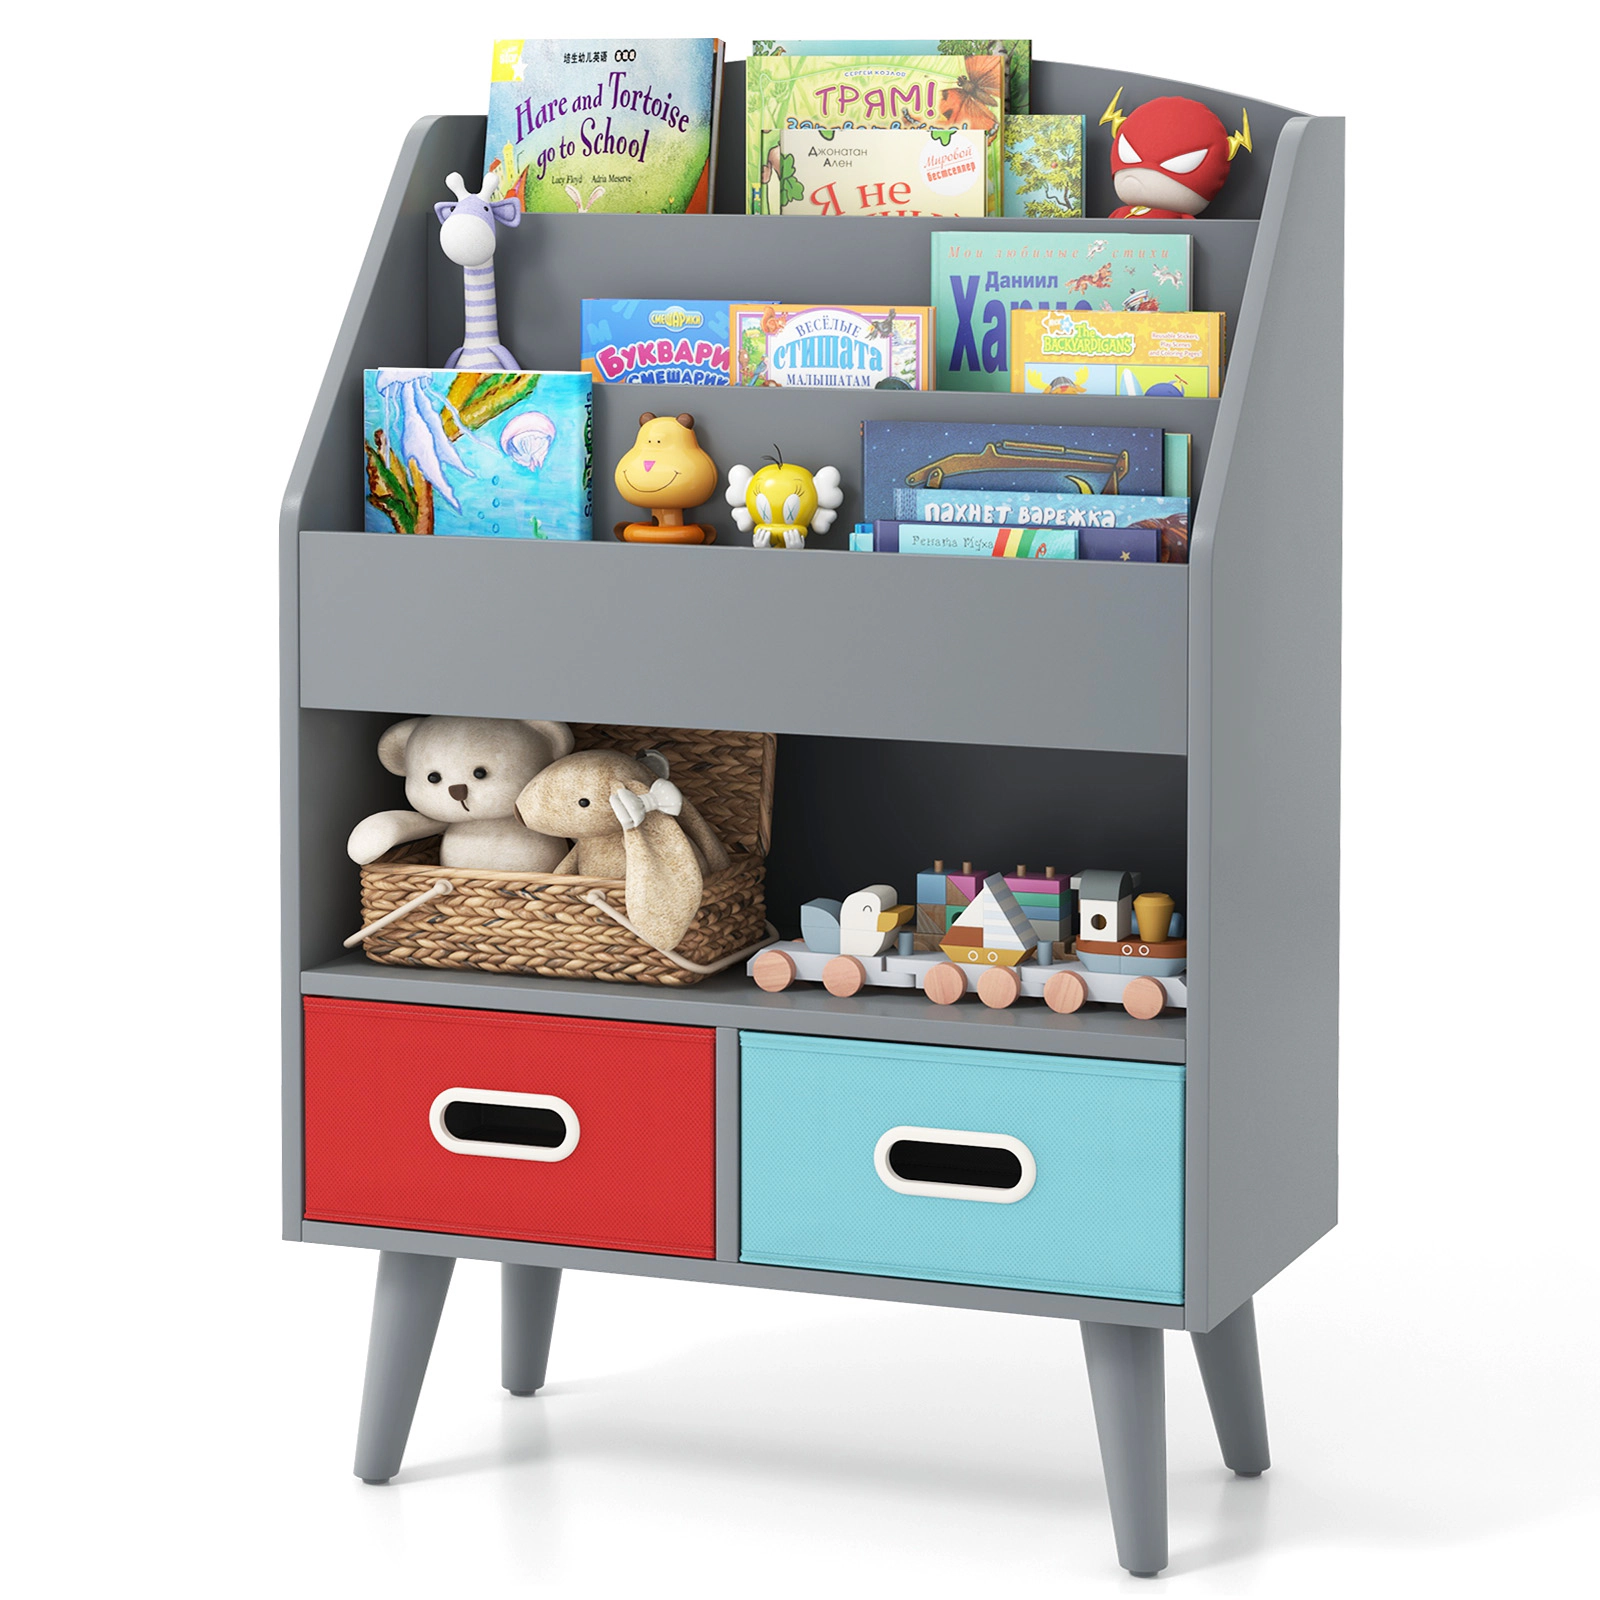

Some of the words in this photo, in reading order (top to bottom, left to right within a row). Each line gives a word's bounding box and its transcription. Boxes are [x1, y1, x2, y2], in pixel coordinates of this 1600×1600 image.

[563, 50, 608, 64] 培生幼儿英语
[515, 97, 568, 144] Hare
[572, 83, 603, 113] and
[608, 71, 690, 133] Tortoise
[815, 81, 936, 119] ТРЯМ!
[536, 147, 556, 180] go
[559, 136, 576, 159] to
[580, 116, 650, 163] School
[808, 146, 868, 157] Джонатан
[823, 158, 853, 168] Ален
[924, 145, 973, 170] Мировой
[566, 174, 583, 184] Floyd
[608, 174, 633, 184] Meserve
[926, 161, 977, 183] бестселлер
[810, 182, 846, 216] Я
[857, 182, 912, 209] не
[948, 246, 984, 259] Мои
[994, 245, 1080, 259] любимые
[1112, 248, 1170, 259] стихи
[985, 271, 1059, 292] Даниил
[650, 311, 702, 328] СМЕШАРИКИ
[795, 315, 863, 338] ВЕСЁЛЫЕ
[1075, 322, 1096, 338] The
[1043, 335, 1134, 355] BACKYARDIGANS
[1161, 350, 1184, 358] Coloring
[786, 373, 870, 387] МАЛЫШАТАМ
[912, 535, 958, 548] Рената
[963, 537, 994, 551] Муха
